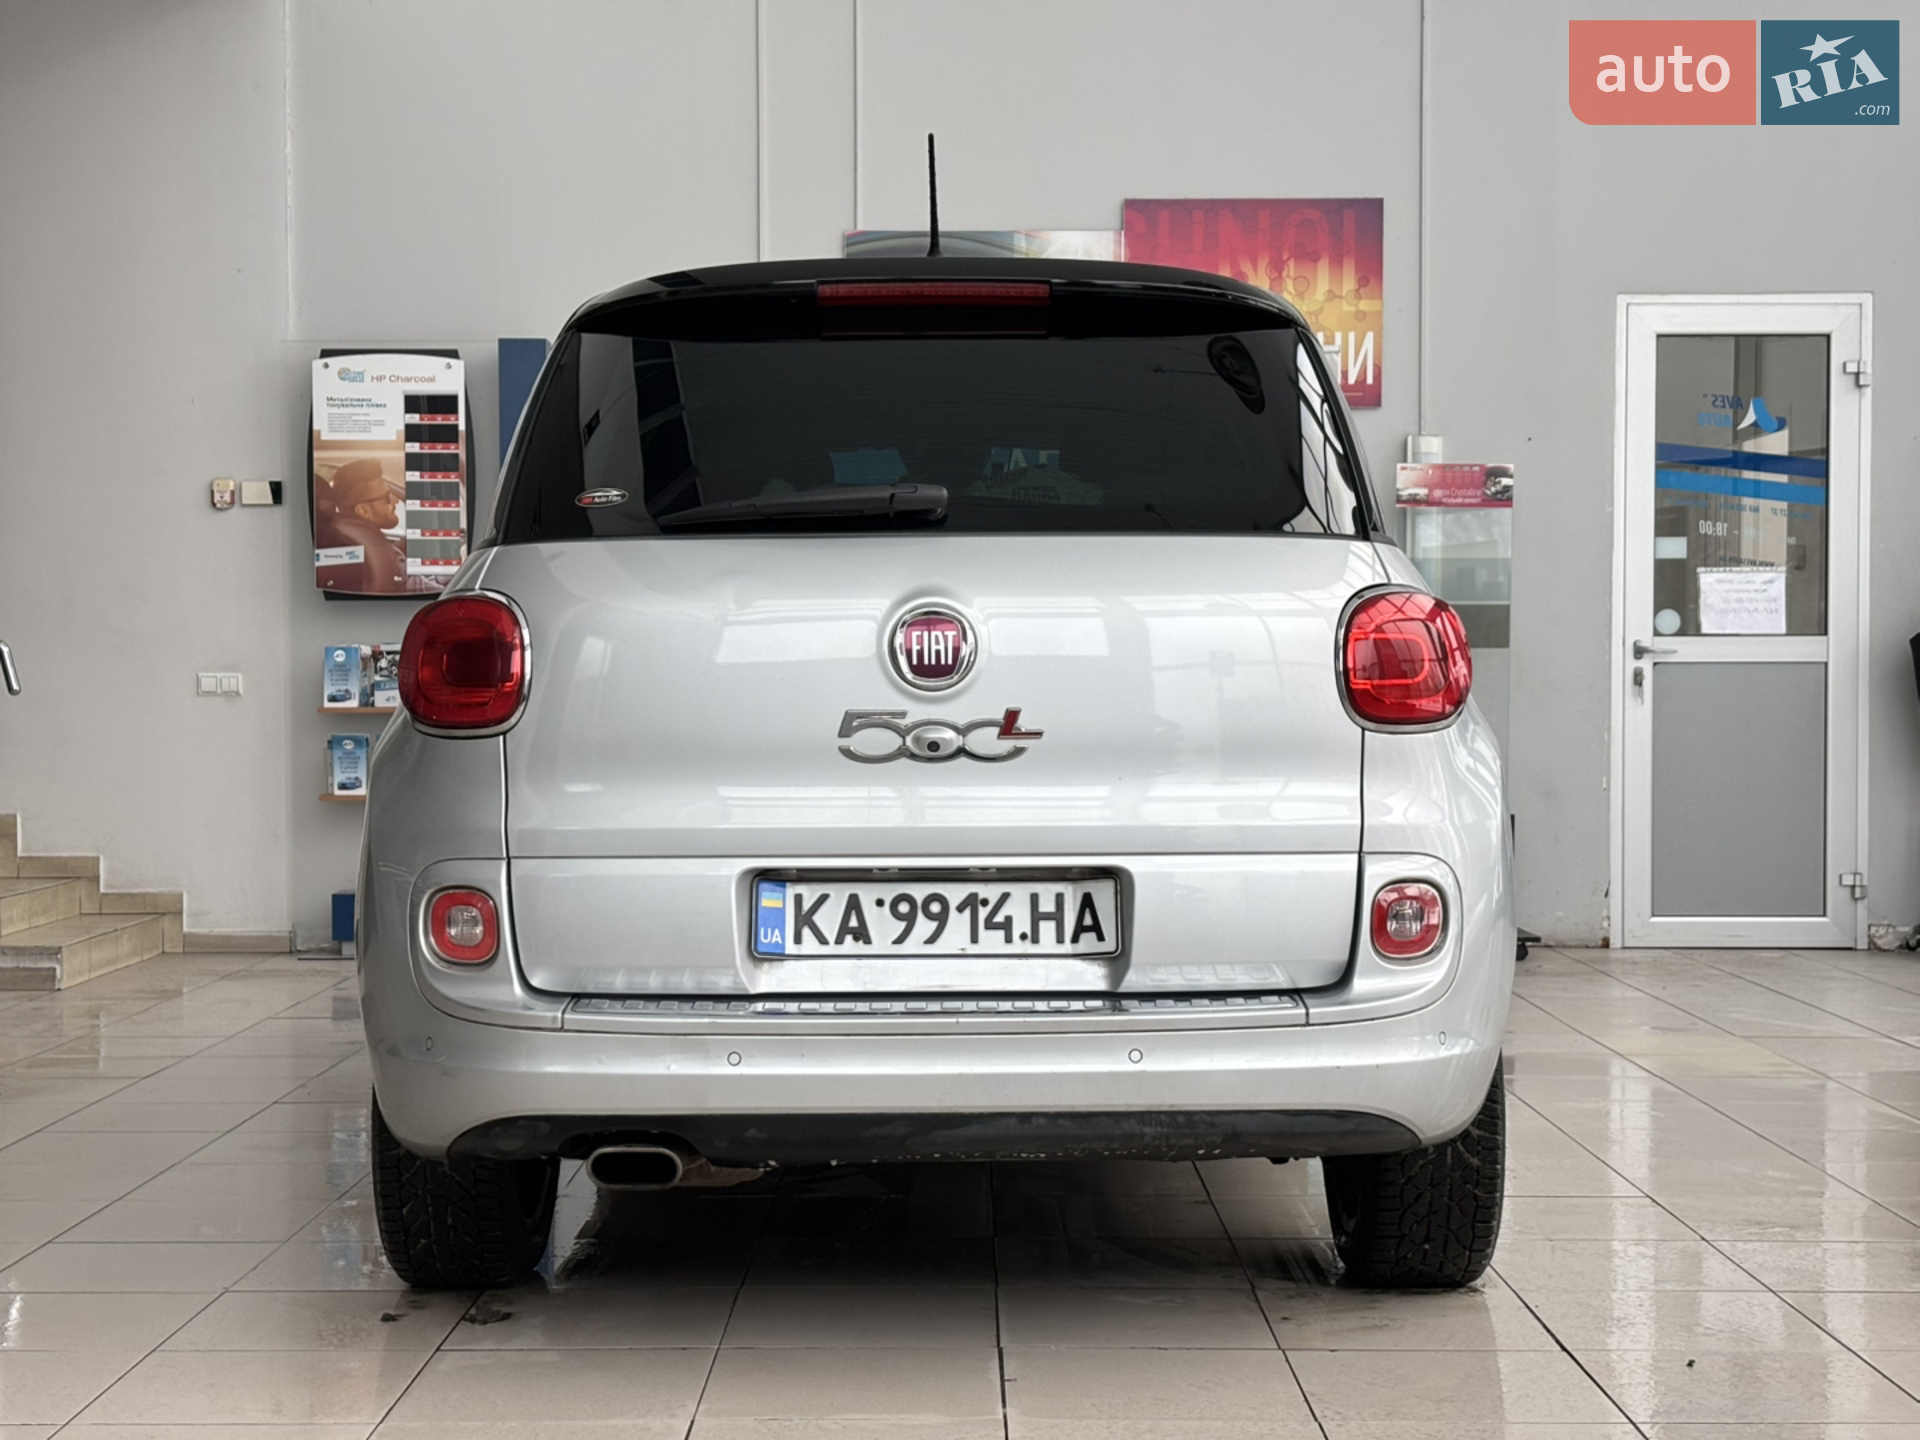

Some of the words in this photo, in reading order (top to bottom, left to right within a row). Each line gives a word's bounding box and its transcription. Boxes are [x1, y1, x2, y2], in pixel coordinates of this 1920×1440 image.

[371, 374, 386, 383] HP
[388, 374, 436, 383] Charcoal
[911, 630, 957, 665] FIAT
[793, 892, 872, 945] KA
[889, 892, 1013, 945] 9914
[1030, 891, 1106, 944] HA
[760, 927, 783, 943] UA
